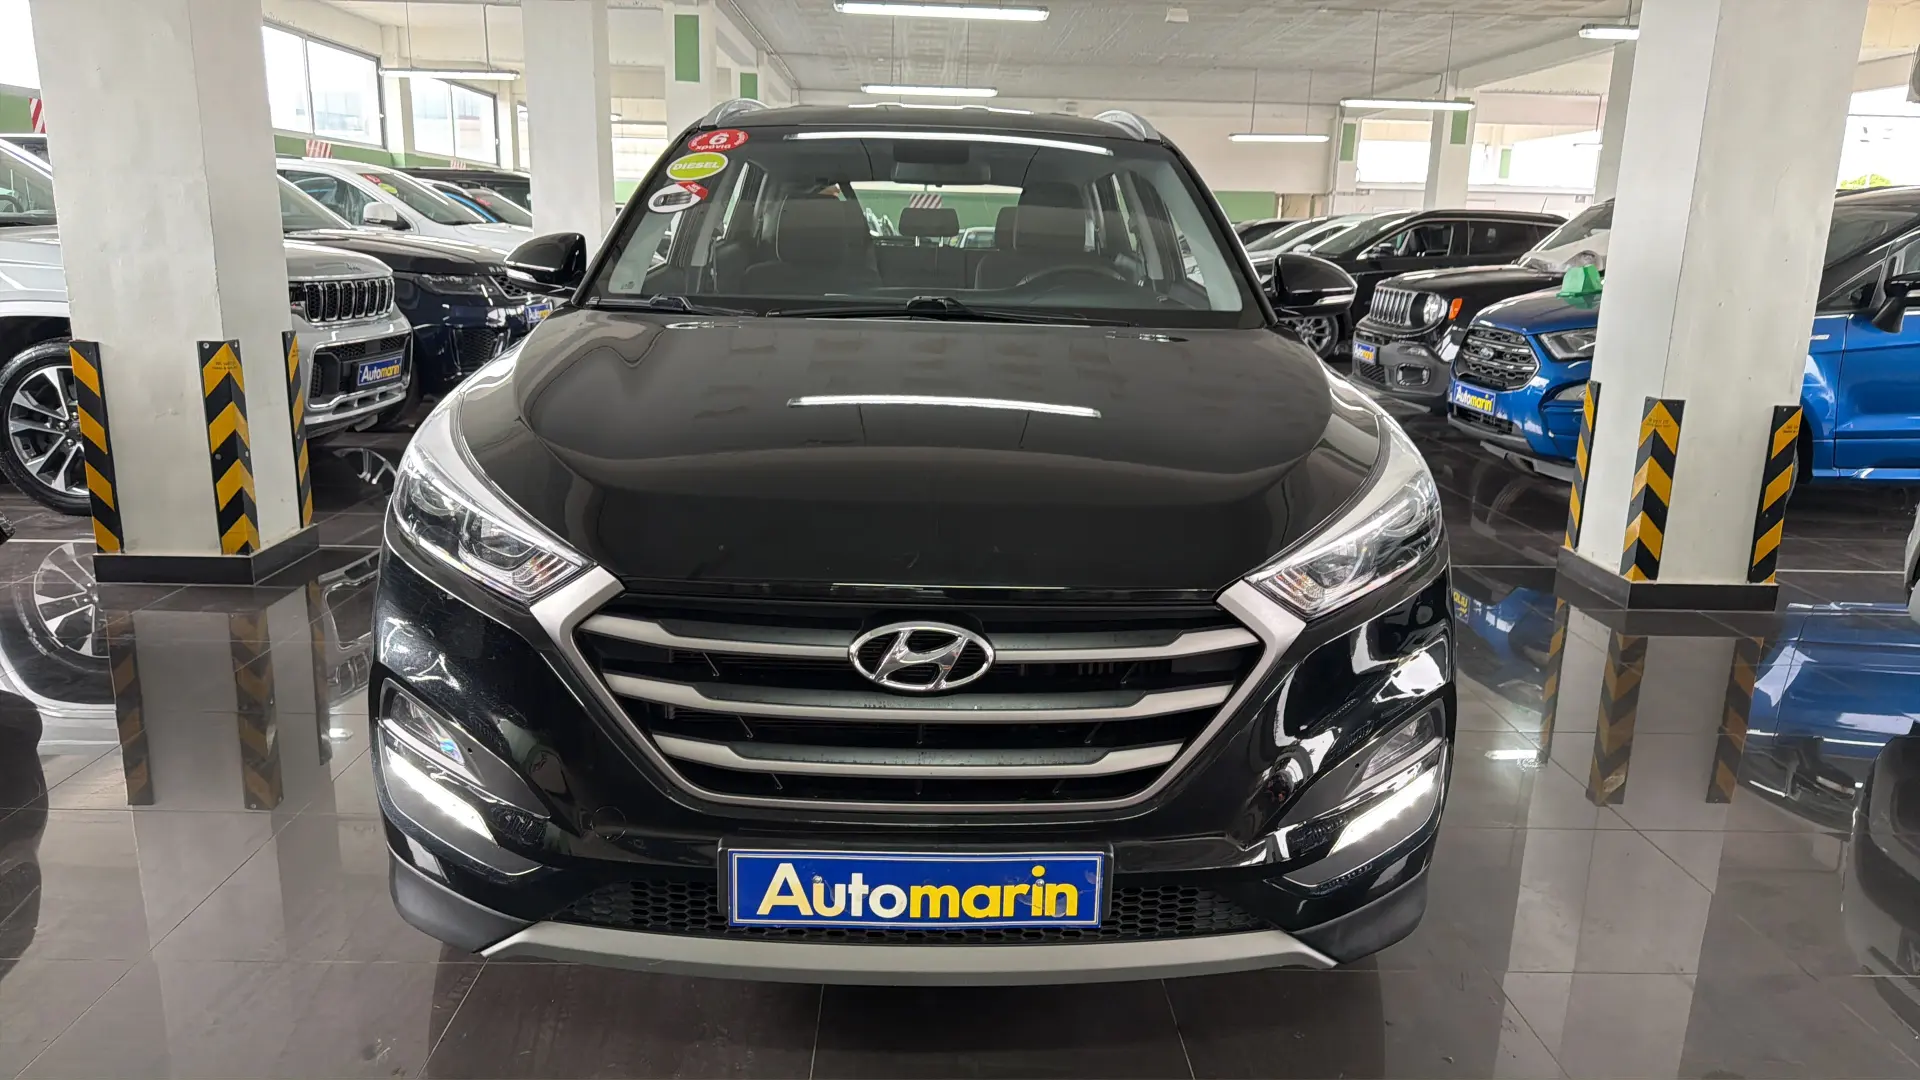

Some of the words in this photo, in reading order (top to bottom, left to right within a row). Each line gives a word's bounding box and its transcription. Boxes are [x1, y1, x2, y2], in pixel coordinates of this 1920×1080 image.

[709, 132, 729, 145] 6
[672, 161, 720, 171] DIESEL
[360, 359, 400, 383] Automarin
[1455, 385, 1493, 412] Automarin
[756, 862, 1078, 919] Automarin
